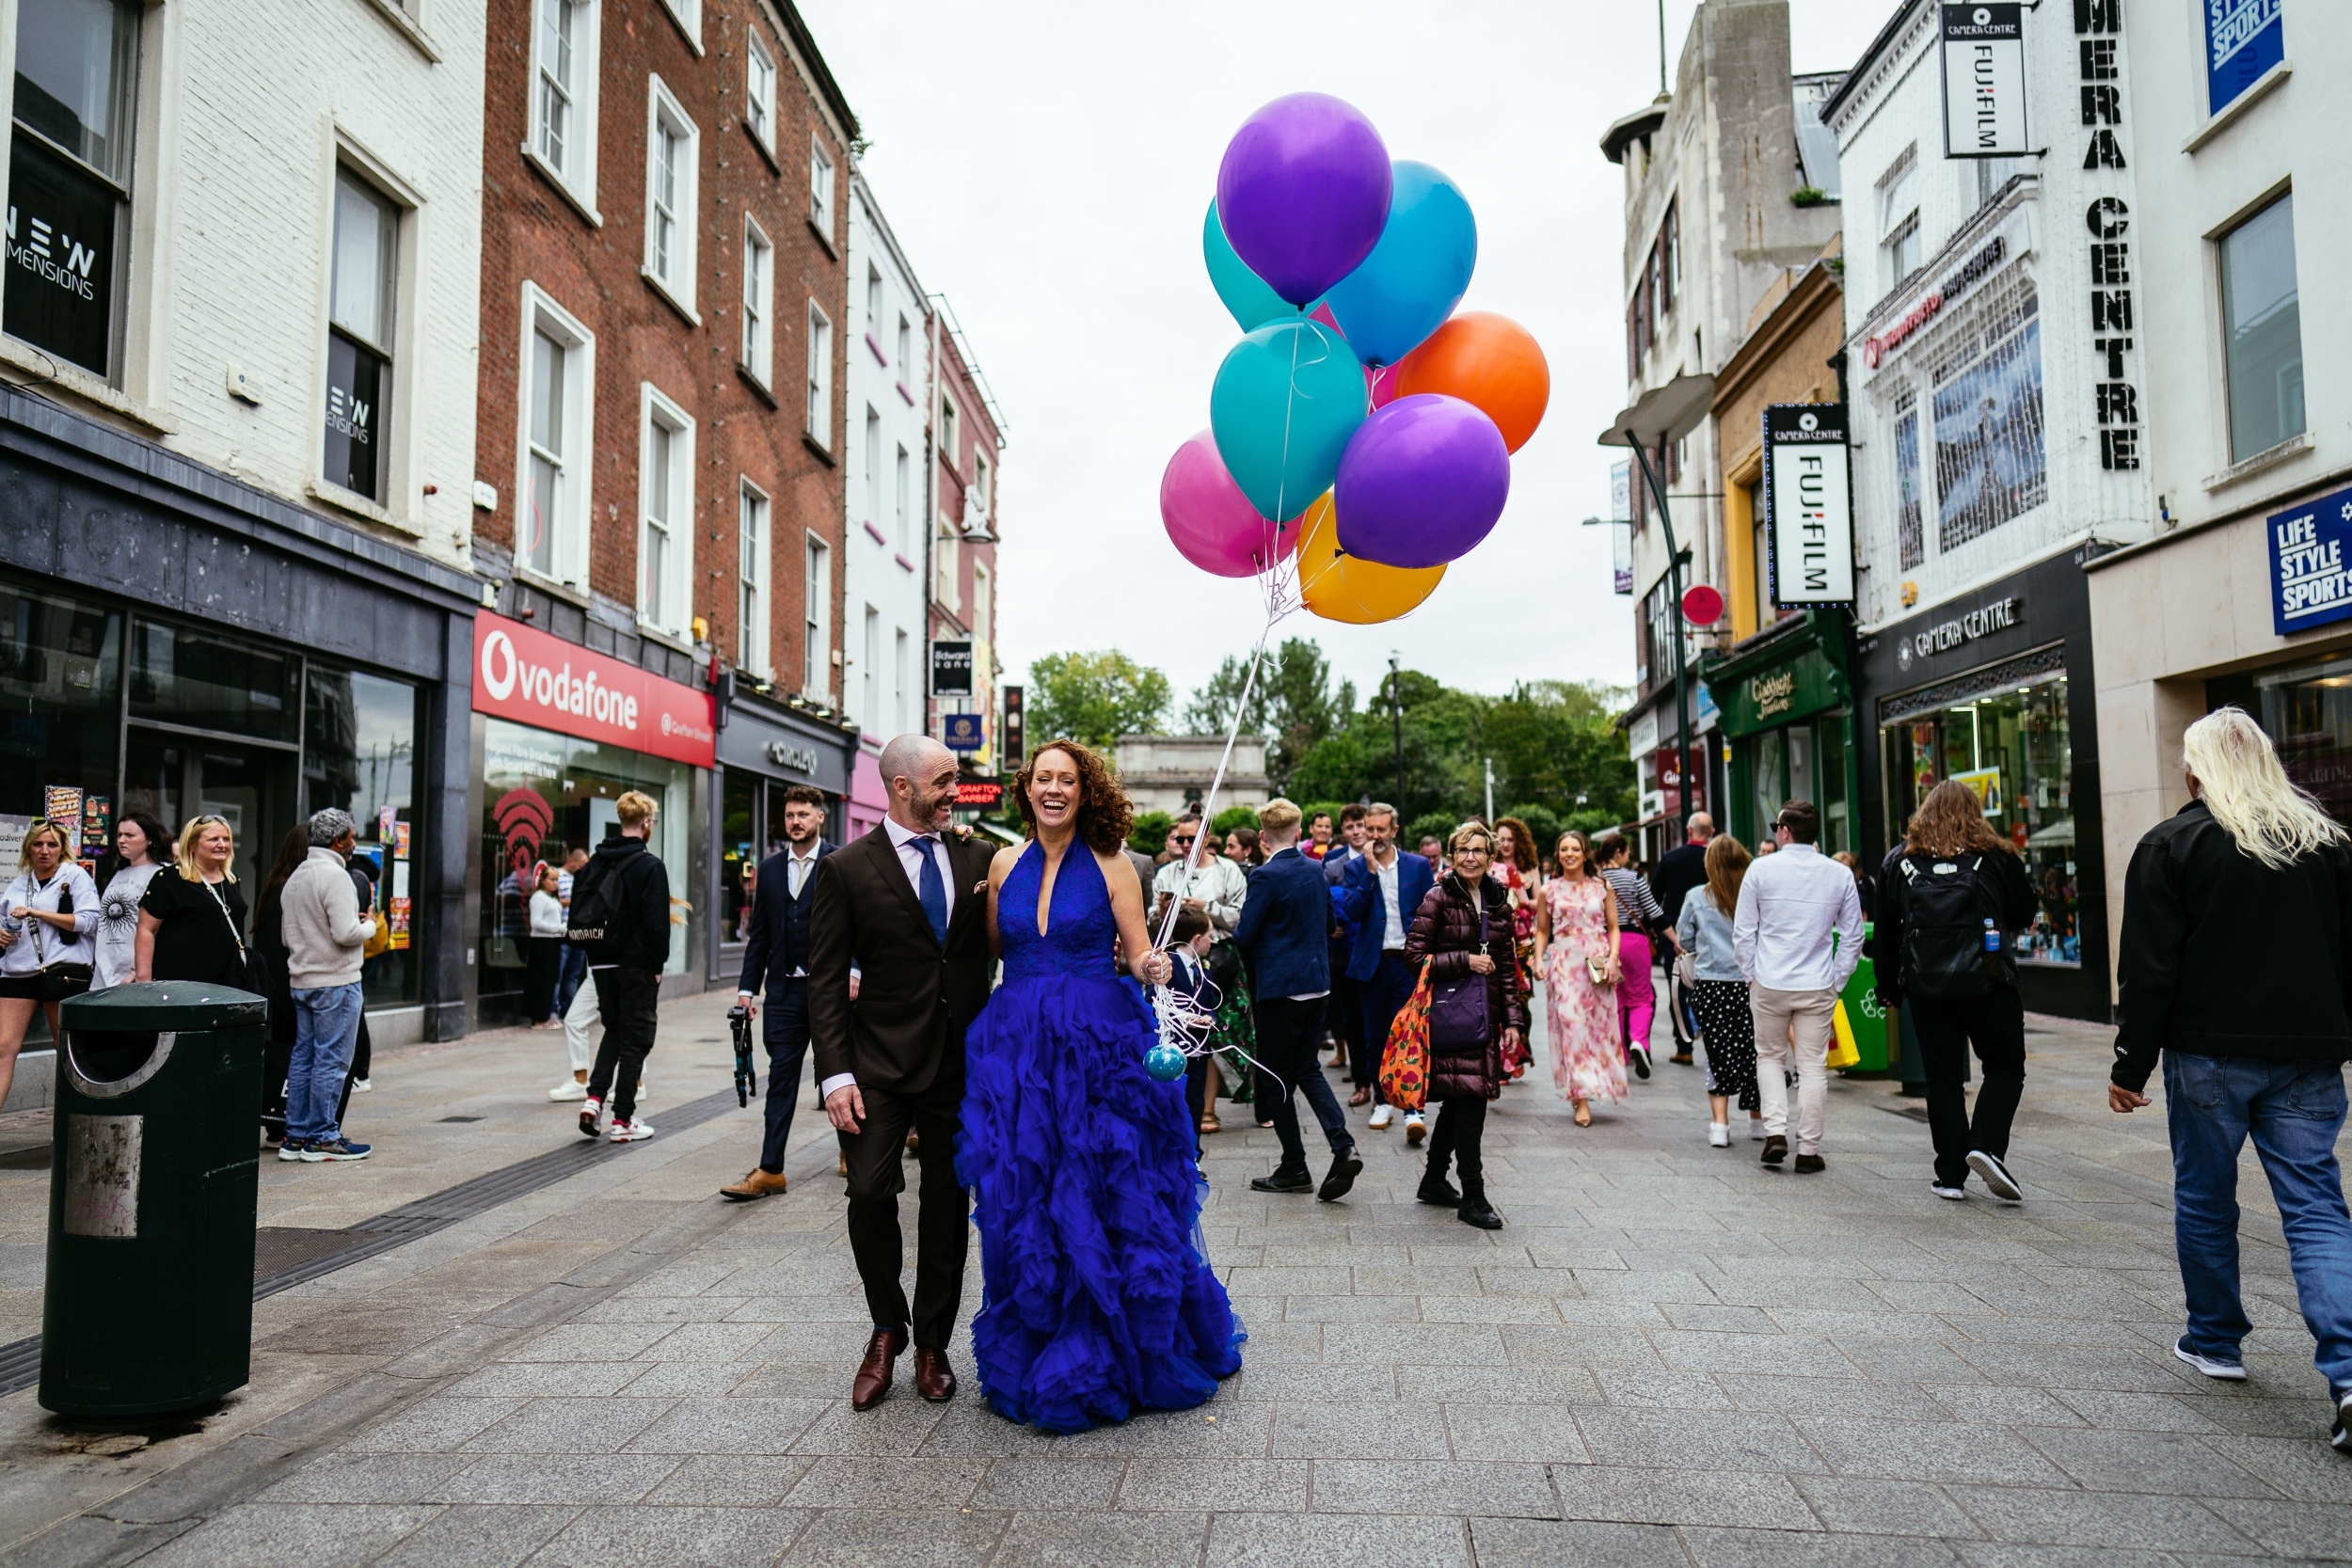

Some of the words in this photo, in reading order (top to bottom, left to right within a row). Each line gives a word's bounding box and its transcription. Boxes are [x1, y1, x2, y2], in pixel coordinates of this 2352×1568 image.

[1948, 24, 1983, 36] CAMERA
[1983, 24, 2017, 35] CENTRE
[1974, 45, 1997, 148] FUJIFILM
[2087, 197, 2140, 471] CENTRE
[1774, 431, 1811, 441] CAMERA
[1811, 429, 1844, 440] CENTRE
[1799, 456, 1828, 591] FUJIFILM
[2277, 514, 2316, 549] LIFE
[2280, 539, 2342, 580] STYLE
[1915, 620, 1962, 657] CAMERA
[1963, 596, 2014, 640] CENTRE
[517, 662, 638, 731] vodafone
